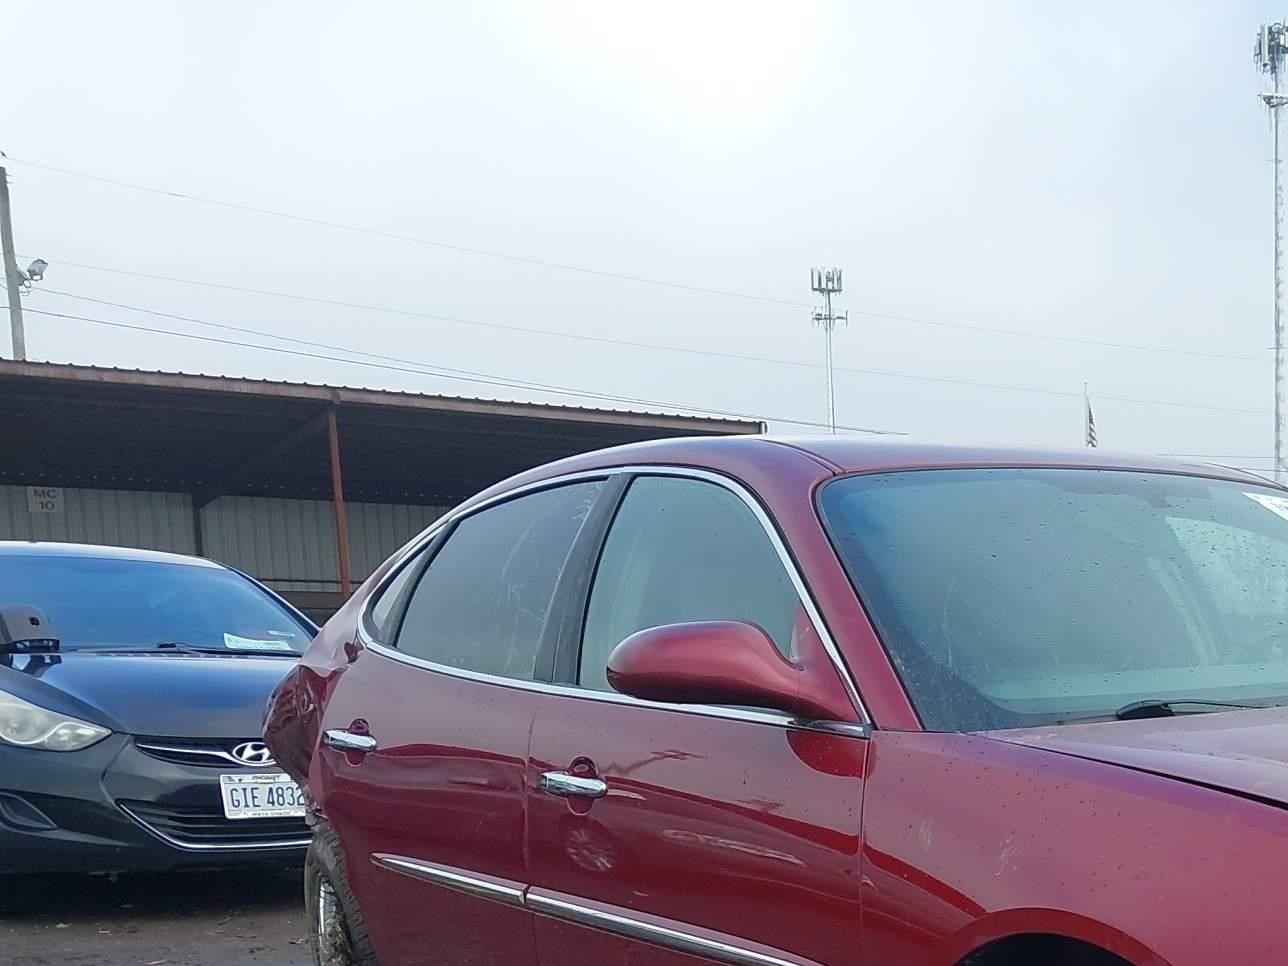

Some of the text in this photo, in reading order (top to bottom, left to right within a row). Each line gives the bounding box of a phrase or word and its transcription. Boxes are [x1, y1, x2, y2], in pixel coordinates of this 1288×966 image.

[33, 489, 57, 499] MC
[38, 501, 55, 510] 10
[230, 786, 305, 808] GIE 4832
